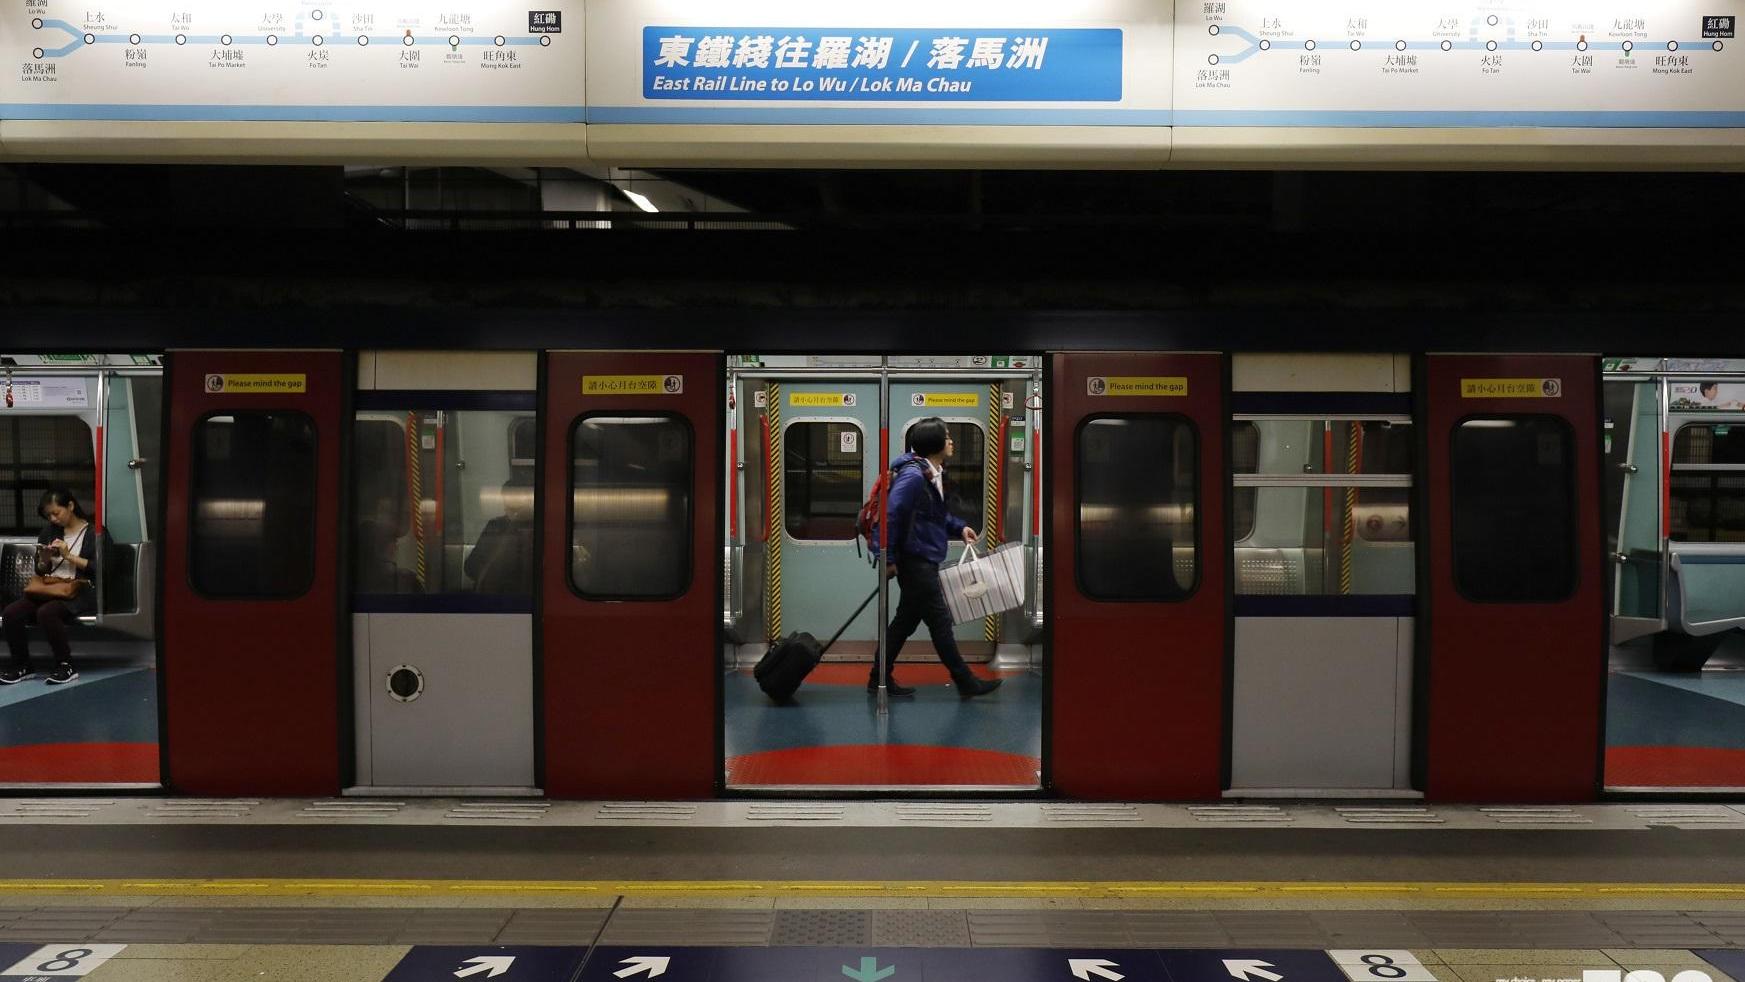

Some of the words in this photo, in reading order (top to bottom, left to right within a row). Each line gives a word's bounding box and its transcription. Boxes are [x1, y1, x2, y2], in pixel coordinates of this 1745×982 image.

[1203, 3, 1225, 14] 羅湖
[86, 11, 104, 23] 上水
[171, 12, 191, 23] 太和
[352, 13, 373, 24] 沙田
[440, 13, 470, 24] 九龍塘
[534, 13, 556, 24] 紅磡
[1263, 18, 1281, 29] 上水
[1347, 18, 1367, 29] 太和
[1528, 19, 1548, 29] 沙田
[1614, 19, 1644, 30] 九龍塘
[1707, 18, 1730, 29] 紅磡
[460, 26, 474, 34] Tong
[211, 50, 243, 60] 大埔墟
[307, 50, 329, 61] 火炭
[400, 50, 420, 61] 大圍
[483, 50, 517, 61] 旺角東
[654, 35, 893, 69] 東鐵綫往羅湖
[901, 40, 916, 68] /
[929, 36, 1049, 69] 落馬洲
[125, 61, 146, 69] Fanling
[1385, 55, 1417, 66] 大埔墟
[1481, 55, 1502, 66] 火炭
[1572, 55, 1592, 67] 大圍
[1655, 56, 1689, 66] 旺角東
[22, 63, 56, 75] 落馬洲
[1197, 70, 1230, 81] 落馬洲
[653, 75, 691, 91] East
[693, 75, 727, 91] Rail
[730, 76, 767, 91] Line
[772, 78, 789, 92] to
[793, 77, 814, 92] Lo
[820, 77, 847, 92] Wu
[850, 77, 859, 92] /
[861, 77, 893, 92] Lok
[896, 77, 923, 92] Ma
[927, 77, 972, 93] Chau
[288, 381, 302, 389] gap
[1169, 384, 1184, 392] gap
[37, 948, 93, 972] 8
[1360, 954, 1407, 978] 8
